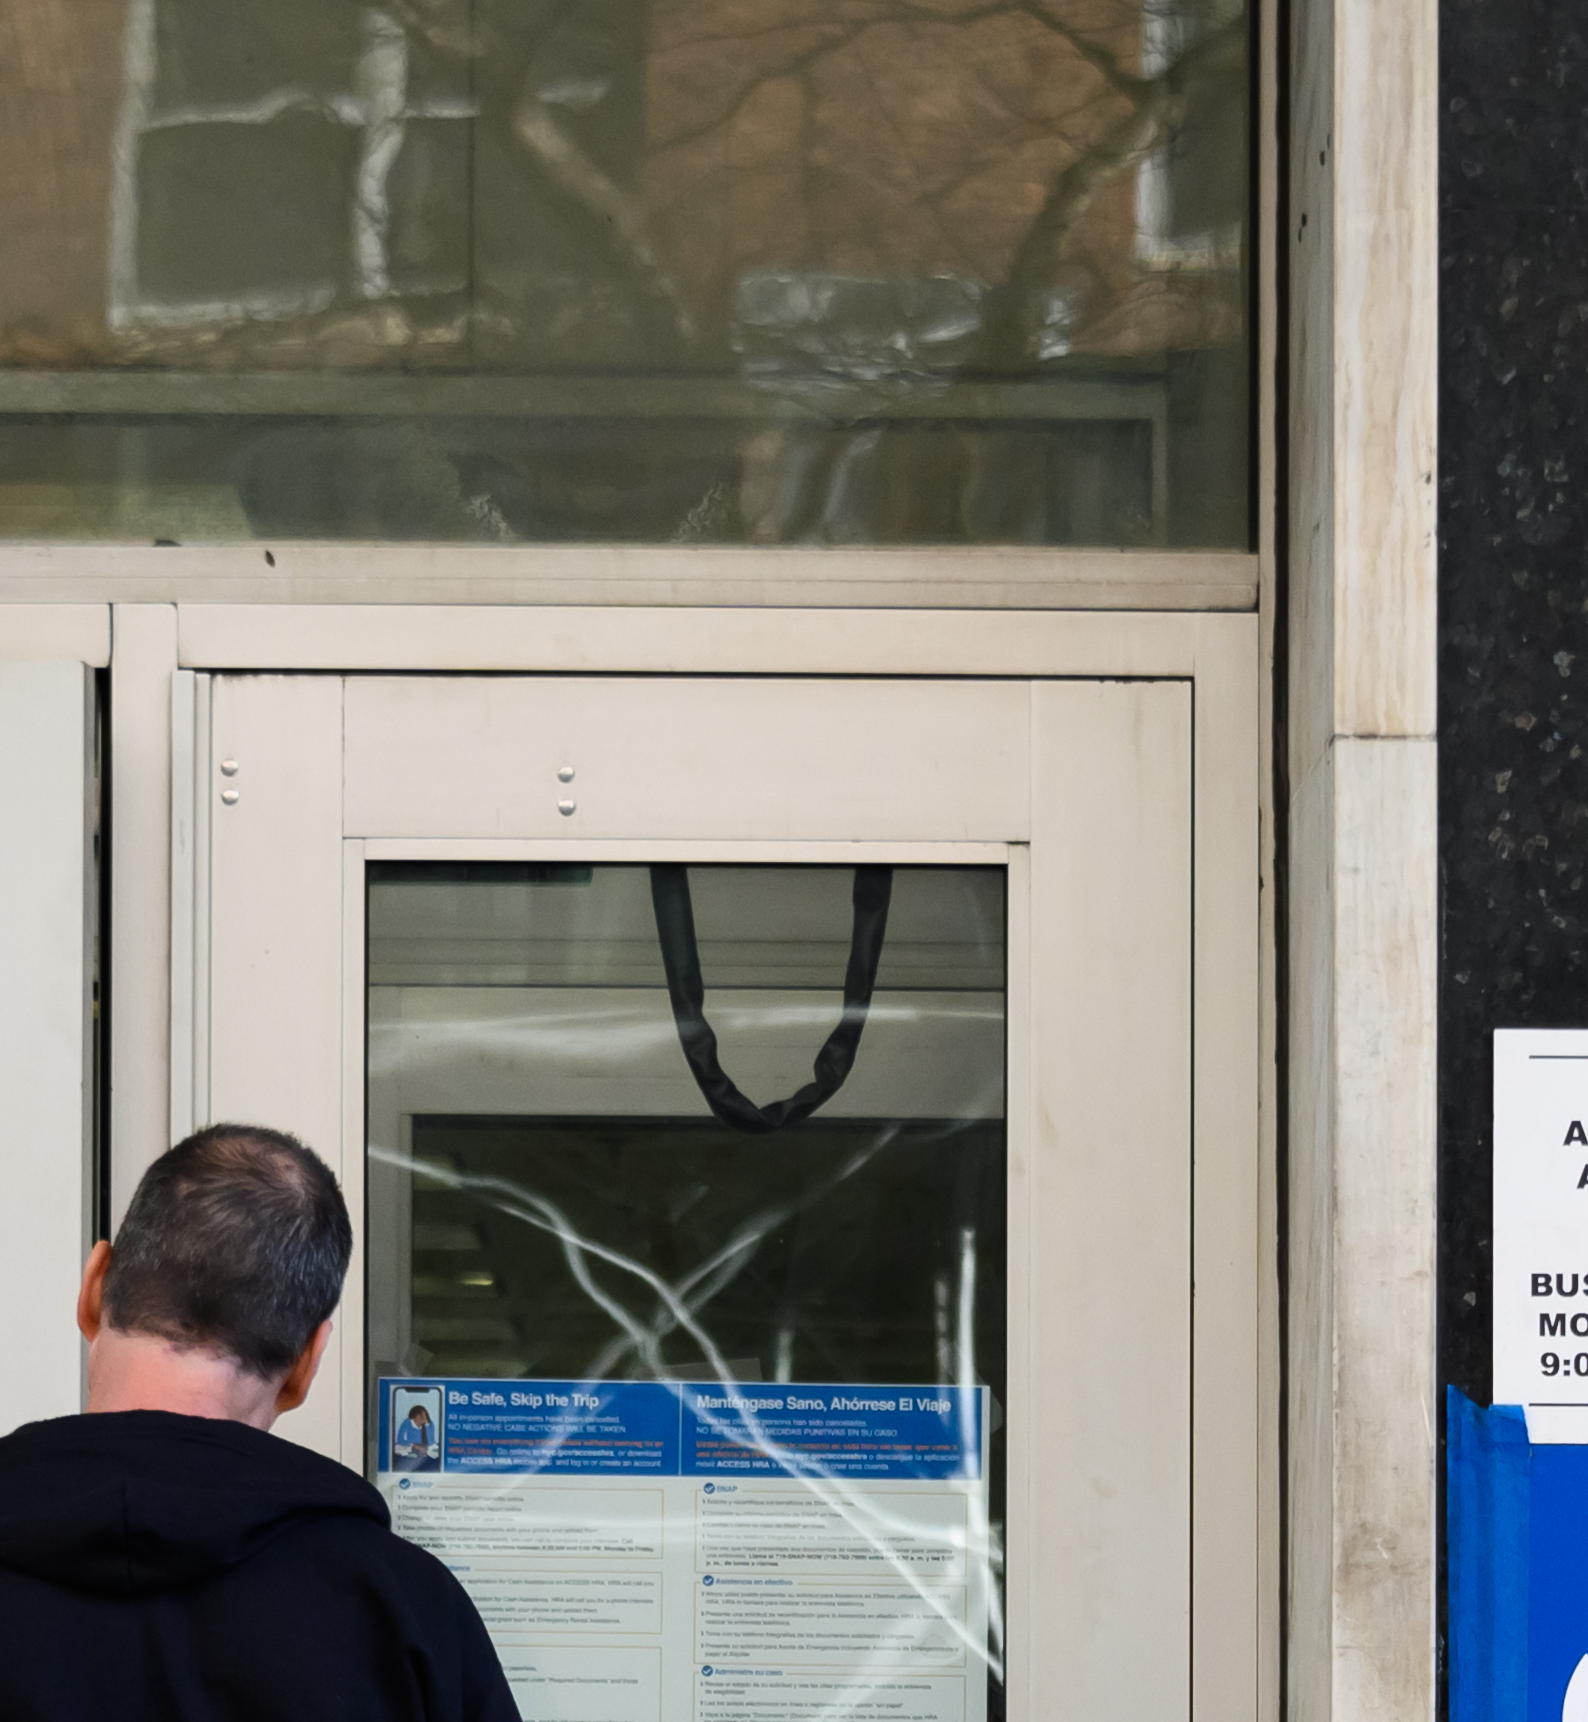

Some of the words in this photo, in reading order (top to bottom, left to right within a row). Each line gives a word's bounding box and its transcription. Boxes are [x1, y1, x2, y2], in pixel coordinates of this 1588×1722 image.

[448, 1392, 468, 1406] Be
[471, 1392, 507, 1408] Safe,
[510, 1392, 543, 1409] Skip
[546, 1393, 569, 1406] the
[572, 1393, 599, 1409] Trip
[697, 1395, 783, 1414] Manténgase
[786, 1396, 827, 1413] Sano,
[831, 1396, 896, 1412] Ahórrese
[899, 1397, 913, 1411] El
[917, 1398, 951, 1414] Viaje
[461, 1424, 502, 1432] NEGATIVE
[504, 1424, 526, 1432] CASE
[528, 1425, 563, 1433] ACTIONS
